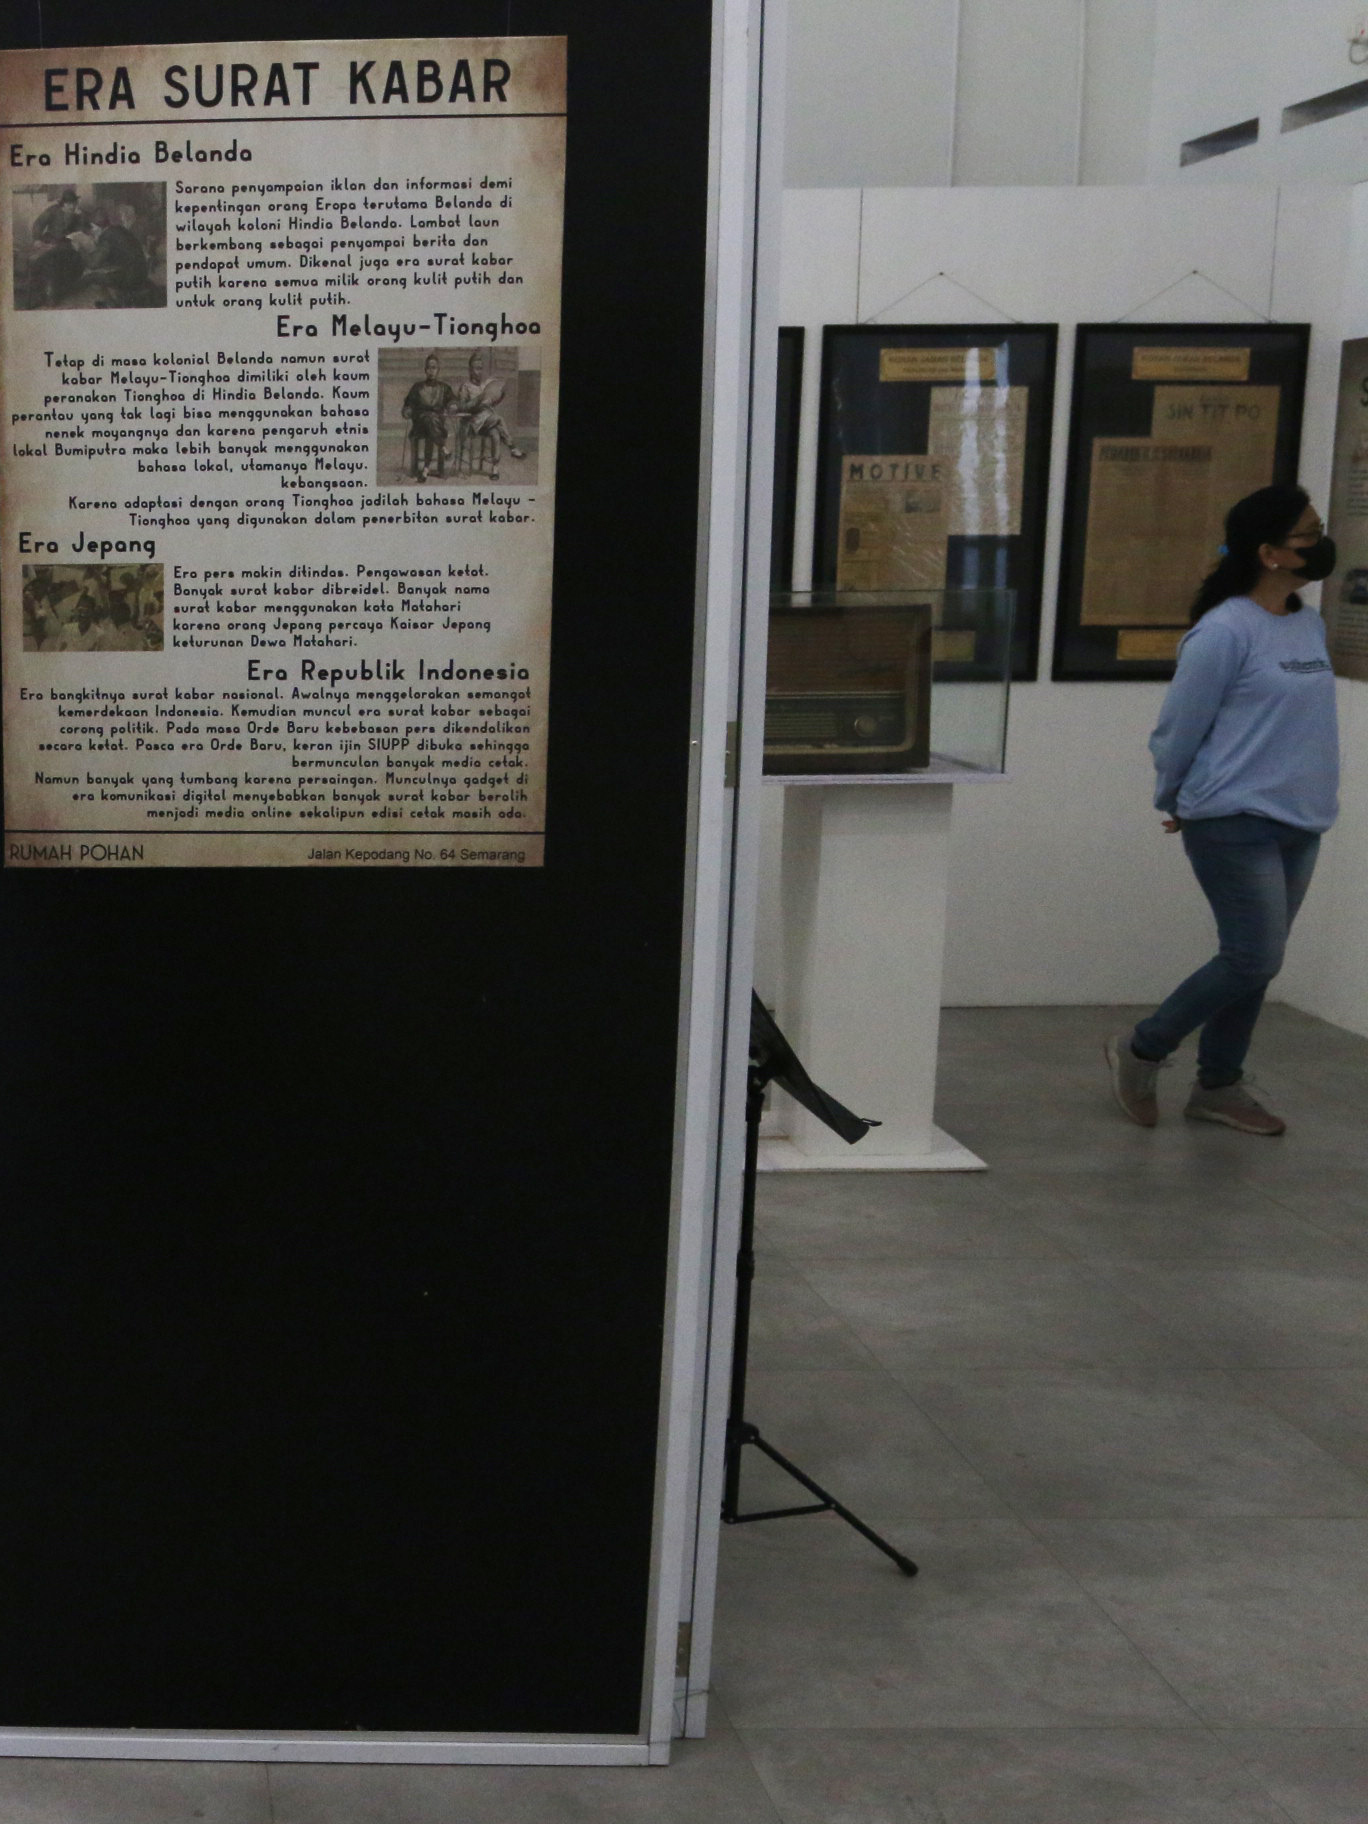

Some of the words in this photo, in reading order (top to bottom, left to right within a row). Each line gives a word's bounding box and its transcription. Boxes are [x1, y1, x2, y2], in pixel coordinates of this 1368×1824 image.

[44, 66, 136, 112] ERA
[163, 61, 320, 109] SURAT
[349, 58, 511, 105] KABAR
[10, 143, 51, 167] Era
[65, 141, 141, 166] Hindia
[155, 138, 252, 164] Belanda
[175, 180, 225, 194] Sarana
[231, 180, 323, 197] penyampaian
[330, 177, 366, 191] iklan
[373, 177, 399, 191] dan
[406, 176, 472, 190] informasi
[479, 175, 512, 189] demi
[175, 199, 261, 217] kepentingan
[267, 203, 308, 215] orang
[315, 197, 356, 215] Eropa
[362, 196, 428, 210] terutama
[435, 194, 492, 209] Belanda
[499, 194, 512, 208] di
[176, 236, 262, 254] berkembang
[269, 235, 323, 253] sebagai
[330, 235, 405, 253] penyampai
[412, 233, 456, 247] berita
[462, 233, 488, 247] dan
[175, 275, 212, 293] putih
[218, 274, 267, 288] karena
[274, 278, 318, 287] semua
[325, 272, 359, 287] milik
[367, 277, 407, 290] orang
[413, 271, 448, 285] kulit
[454, 271, 491, 289] putih
[498, 270, 523, 285] dan
[277, 314, 318, 338] Era
[332, 312, 541, 343] Melayu-Tionghoa
[43, 351, 85, 372] Tetap
[91, 353, 104, 367] di
[111, 358, 147, 367] masa
[153, 351, 210, 366] kolonial
[217, 351, 273, 365] Belanda
[280, 355, 325, 364] namun
[332, 349, 370, 363] surat
[44, 389, 117, 408] peranakan
[123, 388, 185, 406] Tionghoa
[192, 387, 205, 401] di
[212, 387, 256, 401] Hindia
[263, 386, 324, 400] Belanda.
[332, 385, 370, 399] Kaum
[45, 425, 85, 439] nenek
[91, 429, 169, 442] moyangnya
[175, 423, 201, 437] dan
[207, 423, 255, 437] karena
[262, 421, 328, 440] pengaruh
[335, 421, 369, 435] etnis
[138, 459, 187, 473] bahasa
[194, 458, 233, 473] lokal,
[241, 458, 308, 475] utamanya
[315, 457, 368, 474] Melayu.
[281, 475, 368, 492] kebangsaan.
[129, 512, 190, 530] Tionghoa
[197, 517, 230, 530] yang
[237, 511, 308, 529] digunakan
[314, 511, 356, 525] dalam
[362, 510, 439, 528] penerbitan
[445, 510, 483, 524] surat
[489, 509, 535, 523] kabar.
[19, 531, 59, 554] Era
[71, 531, 156, 560] Jepang
[174, 565, 198, 579] Era
[204, 571, 235, 583] pers
[241, 565, 282, 578] makin
[288, 564, 349, 578] ditindas.
[356, 564, 442, 581] Pengawasan
[448, 563, 489, 577] ketat.
[173, 600, 210, 614] surat
[216, 599, 257, 613] kabar
[264, 599, 357, 617] menggunakan
[363, 599, 394, 612] kata
[401, 598, 461, 612] Matahari
[173, 634, 244, 648] keturunan
[250, 634, 286, 647] Dewa
[293, 634, 357, 647] Matahari.
[247, 659, 288, 681] Era
[301, 659, 405, 688] Republik
[419, 658, 530, 681] Indonesia
[20, 687, 43, 701] Era
[50, 687, 125, 704] bangkitnya
[132, 687, 168, 700] surat
[175, 687, 215, 700] kabar
[222, 686, 284, 700] nasional.
[291, 686, 350, 704] Awalnya
[356, 686, 460, 703] menggelorakan
[467, 686, 531, 703] semangat
[58, 704, 148, 717] kemerdekaan
[155, 704, 224, 717] Indonesia.
[231, 703, 296, 717] Kemudian
[303, 703, 351, 717] muncul
[358, 709, 381, 717] era
[388, 703, 424, 717] surat
[431, 703, 471, 717] kabar
[478, 703, 531, 720] sebagai
[38, 743, 83, 751] secara
[88, 738, 129, 751] ketat.
[135, 738, 175, 751] Pasca
[181, 743, 204, 751] era
[210, 737, 243, 751] Orde
[250, 737, 287, 752] Baru,
[293, 738, 333, 751] keran
[339, 739, 361, 755] ijin
[368, 737, 410, 751] SIUPP
[416, 738, 463, 751] dibuka
[470, 738, 530, 755] sehingga
[292, 754, 379, 768] bermunculan
[386, 754, 435, 772] banyak
[441, 755, 482, 768] media
[488, 754, 528, 768] cetak.
[35, 771, 80, 785] Namun
[86, 771, 134, 788] banyak
[141, 776, 174, 789] yang
[180, 771, 238, 789] tumbang
[244, 771, 292, 785] karena
[298, 773, 377, 789] persaingan.
[385, 771, 457, 789] Munculnya
[463, 772, 509, 789] gadget
[516, 772, 528, 785] di
[72, 793, 95, 801] era
[101, 788, 176, 801] komunikasi
[182, 788, 227, 805] digital
[232, 788, 326, 805] menyebabkan
[332, 788, 381, 806] banyak
[388, 789, 424, 802] surat
[431, 788, 471, 802] kabar
[478, 788, 528, 802] beralih
[147, 805, 199, 822] menjadi
[205, 805, 245, 818] media
[251, 805, 293, 818] online
[299, 805, 365, 822] sekalipun
[371, 805, 403, 819] edisi
[410, 805, 445, 819] cetak
[452, 806, 492, 819] masih
[498, 806, 526, 819] ada.
[9, 844, 72, 861] RUMAH
[80, 844, 144, 861] POHAN
[307, 848, 342, 860] Jalan
[345, 848, 410, 863] Kepodang
[414, 848, 435, 860] No.
[439, 848, 456, 860] 64
[460, 848, 526, 863] Semarang
